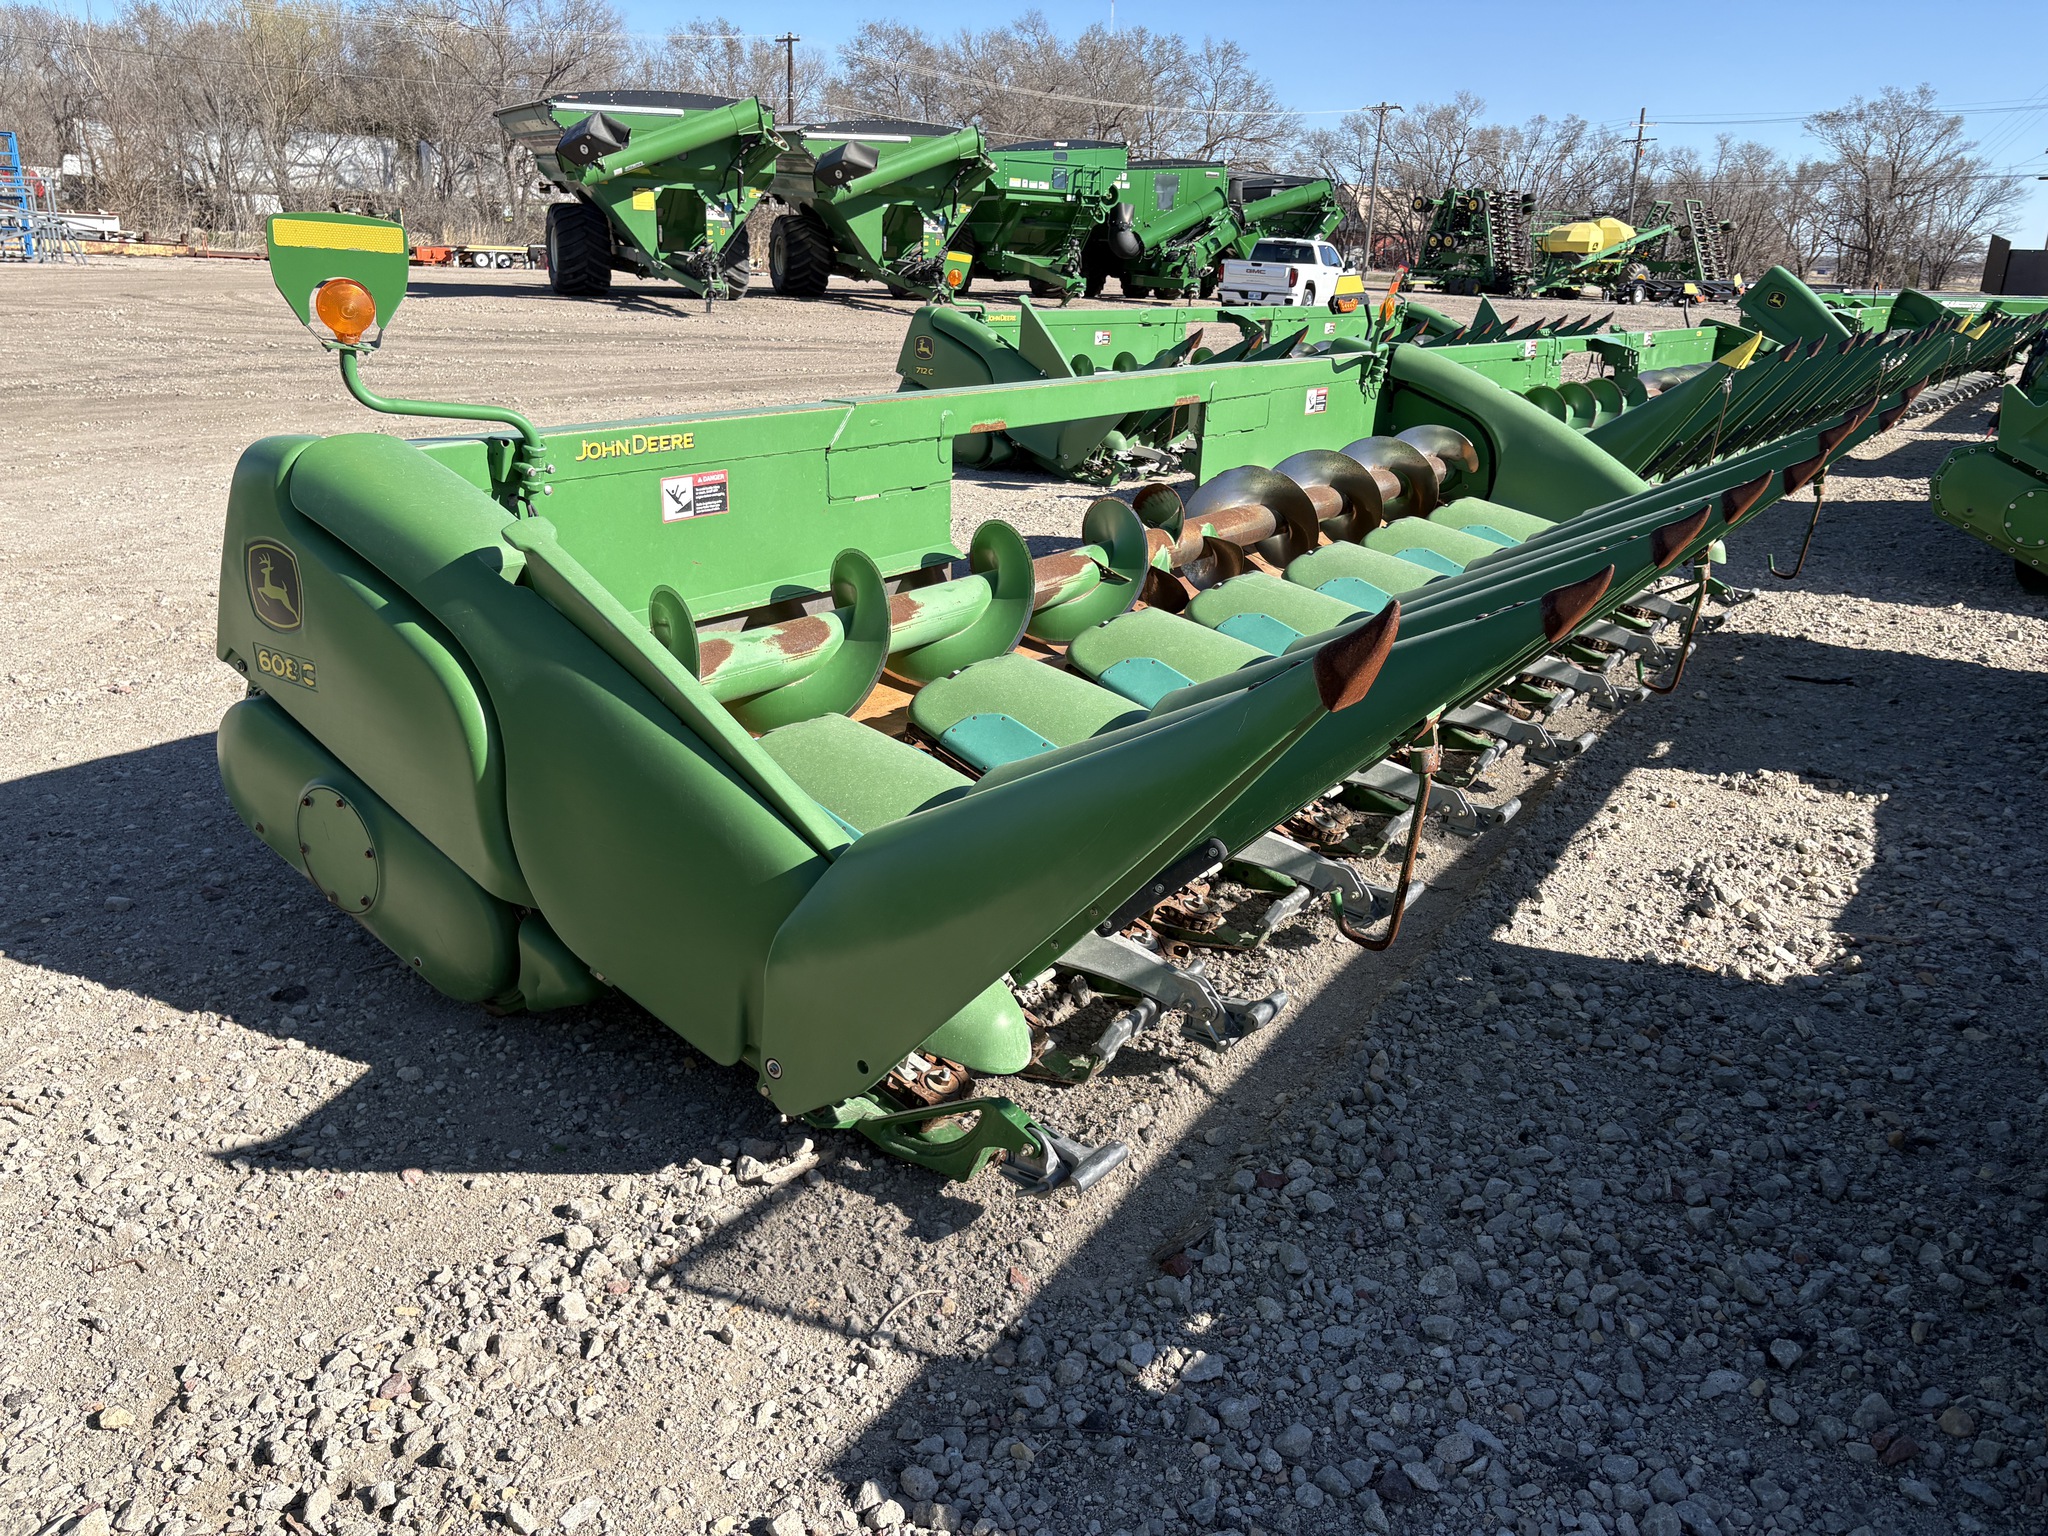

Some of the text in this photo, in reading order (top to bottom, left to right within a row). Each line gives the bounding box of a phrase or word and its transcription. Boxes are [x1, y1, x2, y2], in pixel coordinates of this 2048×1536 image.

[575, 432, 695, 462] JOHN DEERE
[702, 473, 725, 483] DANGER
